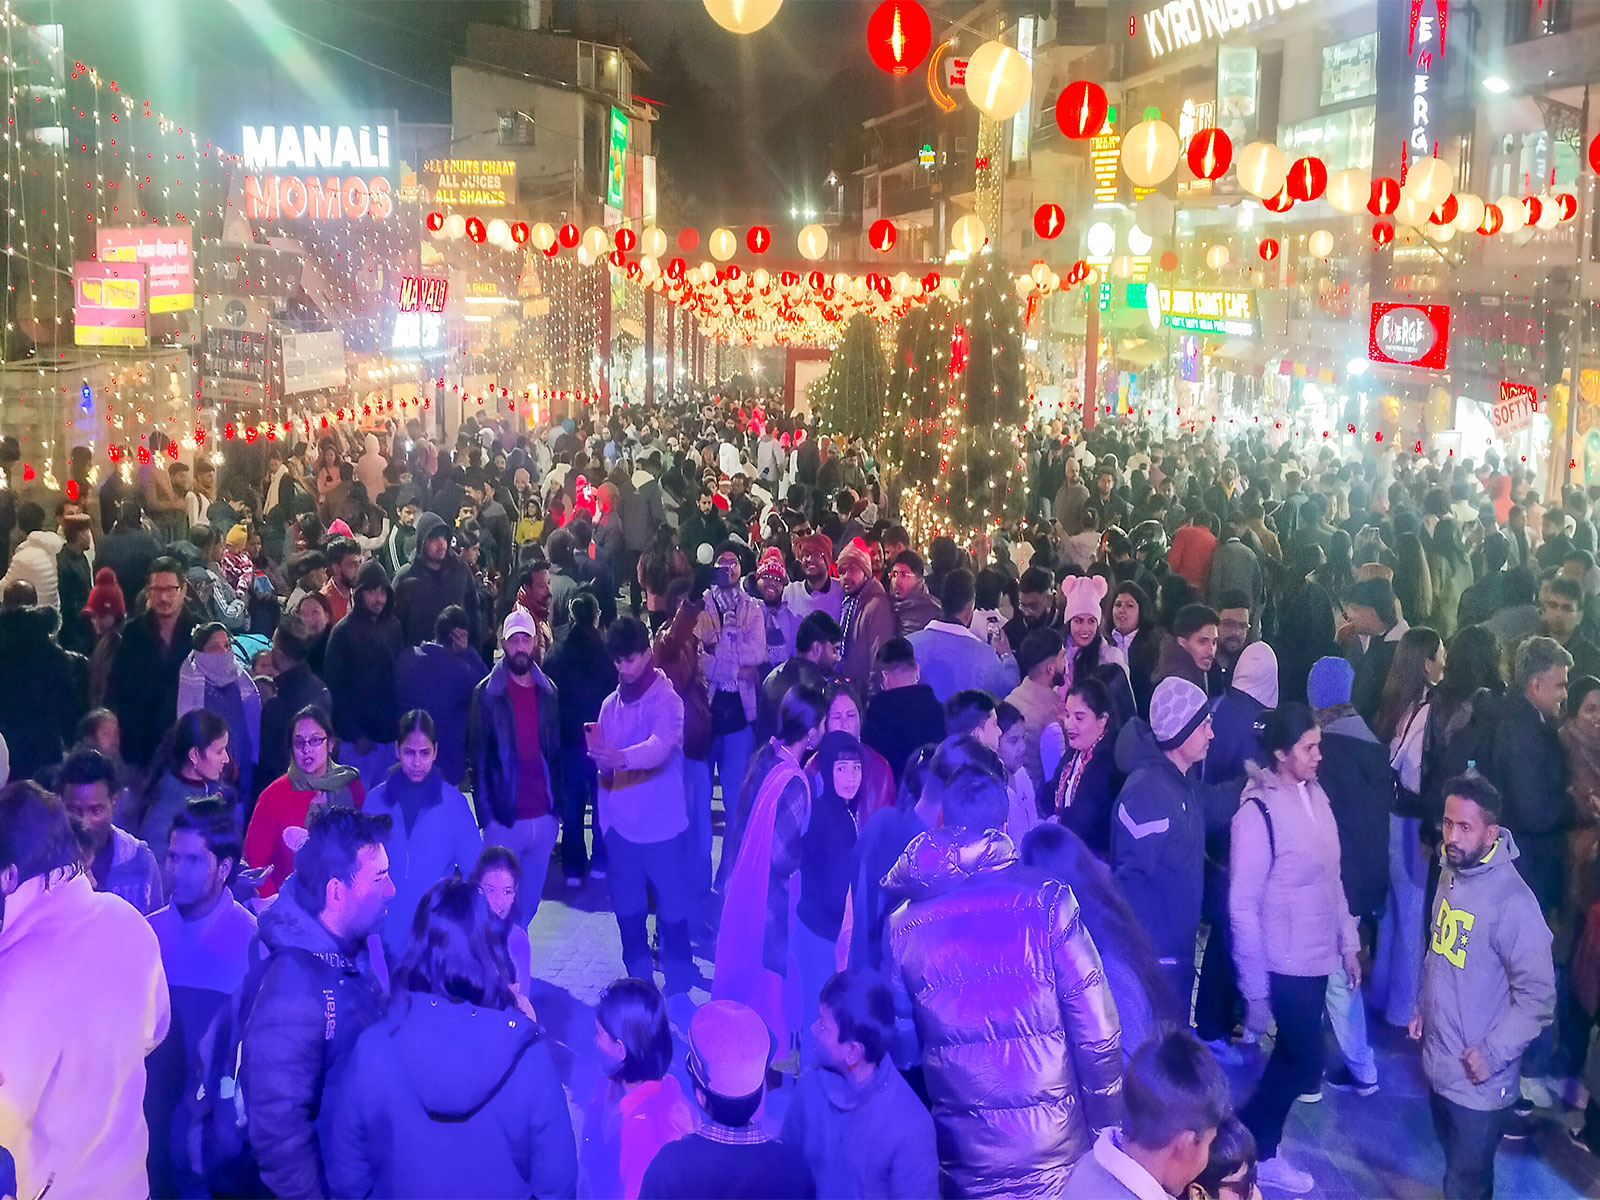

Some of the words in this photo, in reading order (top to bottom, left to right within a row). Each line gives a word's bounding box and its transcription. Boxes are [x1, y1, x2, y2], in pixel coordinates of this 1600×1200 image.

[1143, 0, 1201, 58] KYRO
[1410, 16, 1434, 165] EMERG
[242, 125, 390, 167] MANALI
[444, 159, 480, 174] FRUITS
[481, 160, 516, 175] CHAAT
[245, 176, 392, 219] MOMOS
[436, 189, 457, 203] ALL
[459, 190, 505, 206] SHAKES
[438, 174, 459, 188] ALL
[461, 175, 501, 189] JUICES
[205, 357, 227, 373] STATE
[1493, 396, 1529, 426] SOFTY
[1432, 897, 1475, 970] DC
[322, 990, 336, 1040] safari
